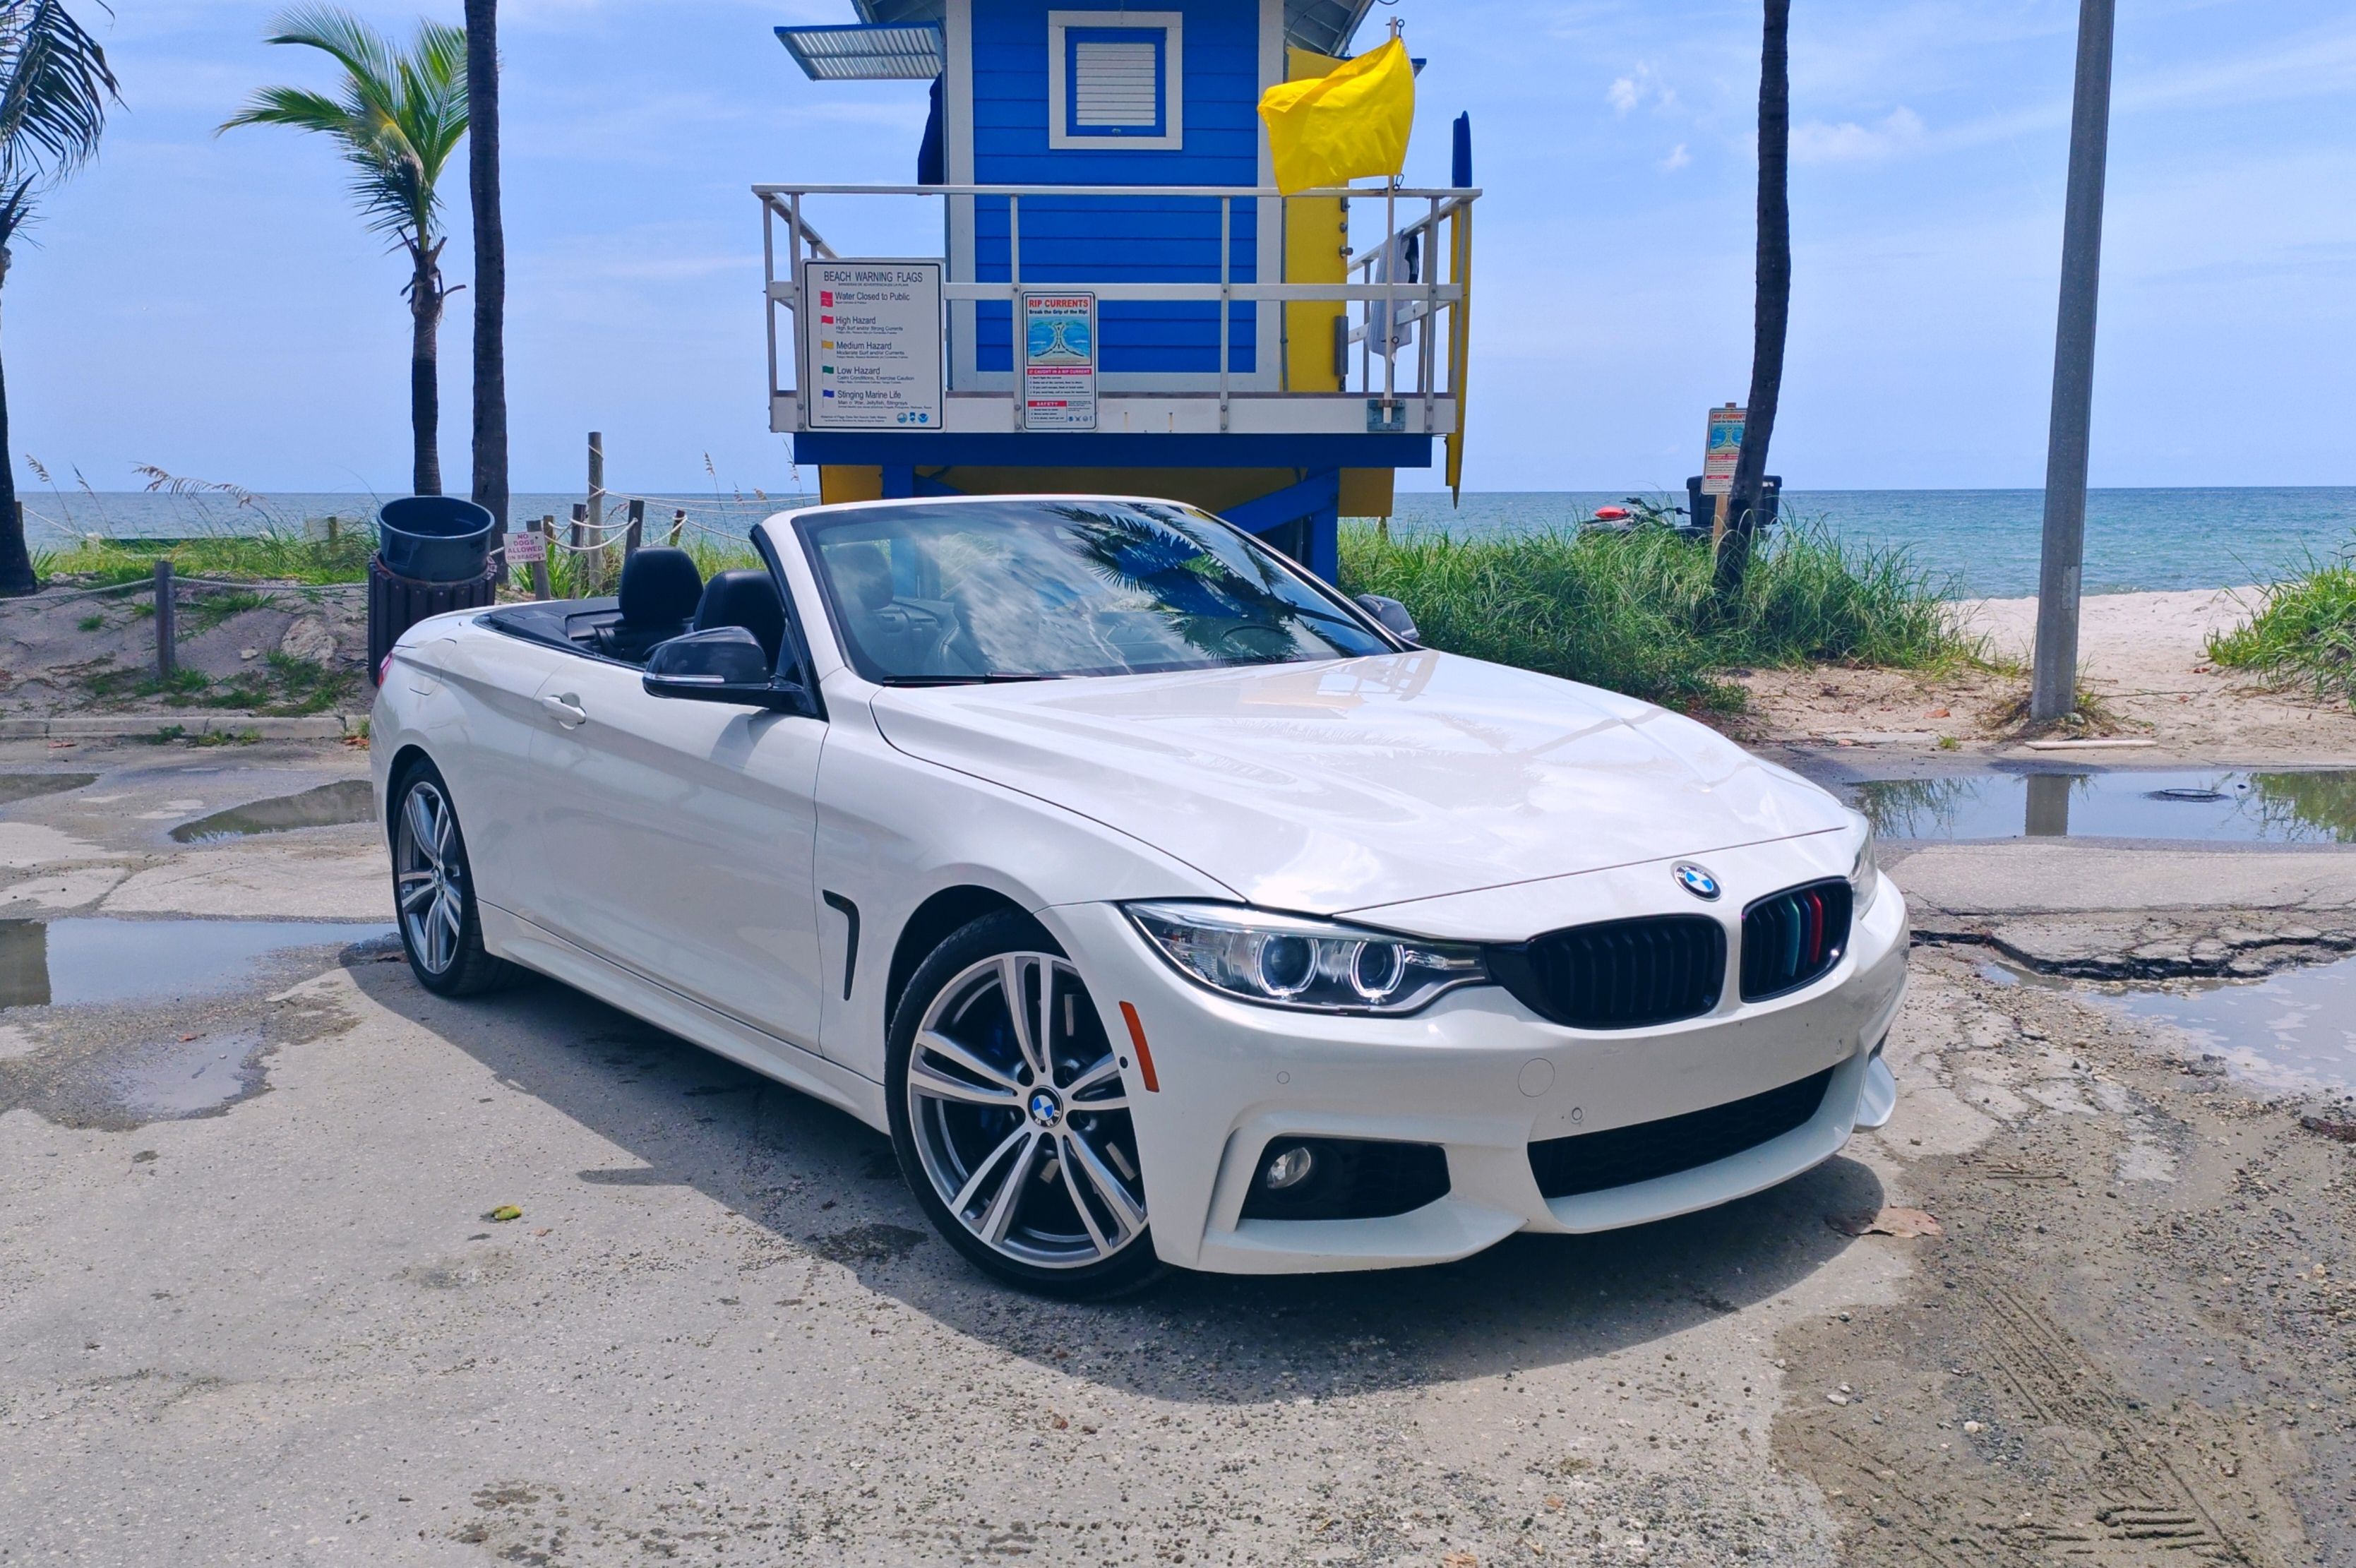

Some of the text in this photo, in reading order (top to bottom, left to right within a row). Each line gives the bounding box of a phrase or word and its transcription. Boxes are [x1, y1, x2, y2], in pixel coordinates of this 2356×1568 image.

[824, 271, 923, 282] BEACH WARNING FLAGS
[890, 292, 910, 301] Public
[836, 316, 851, 325] High
[837, 390, 864, 400] Stinging
